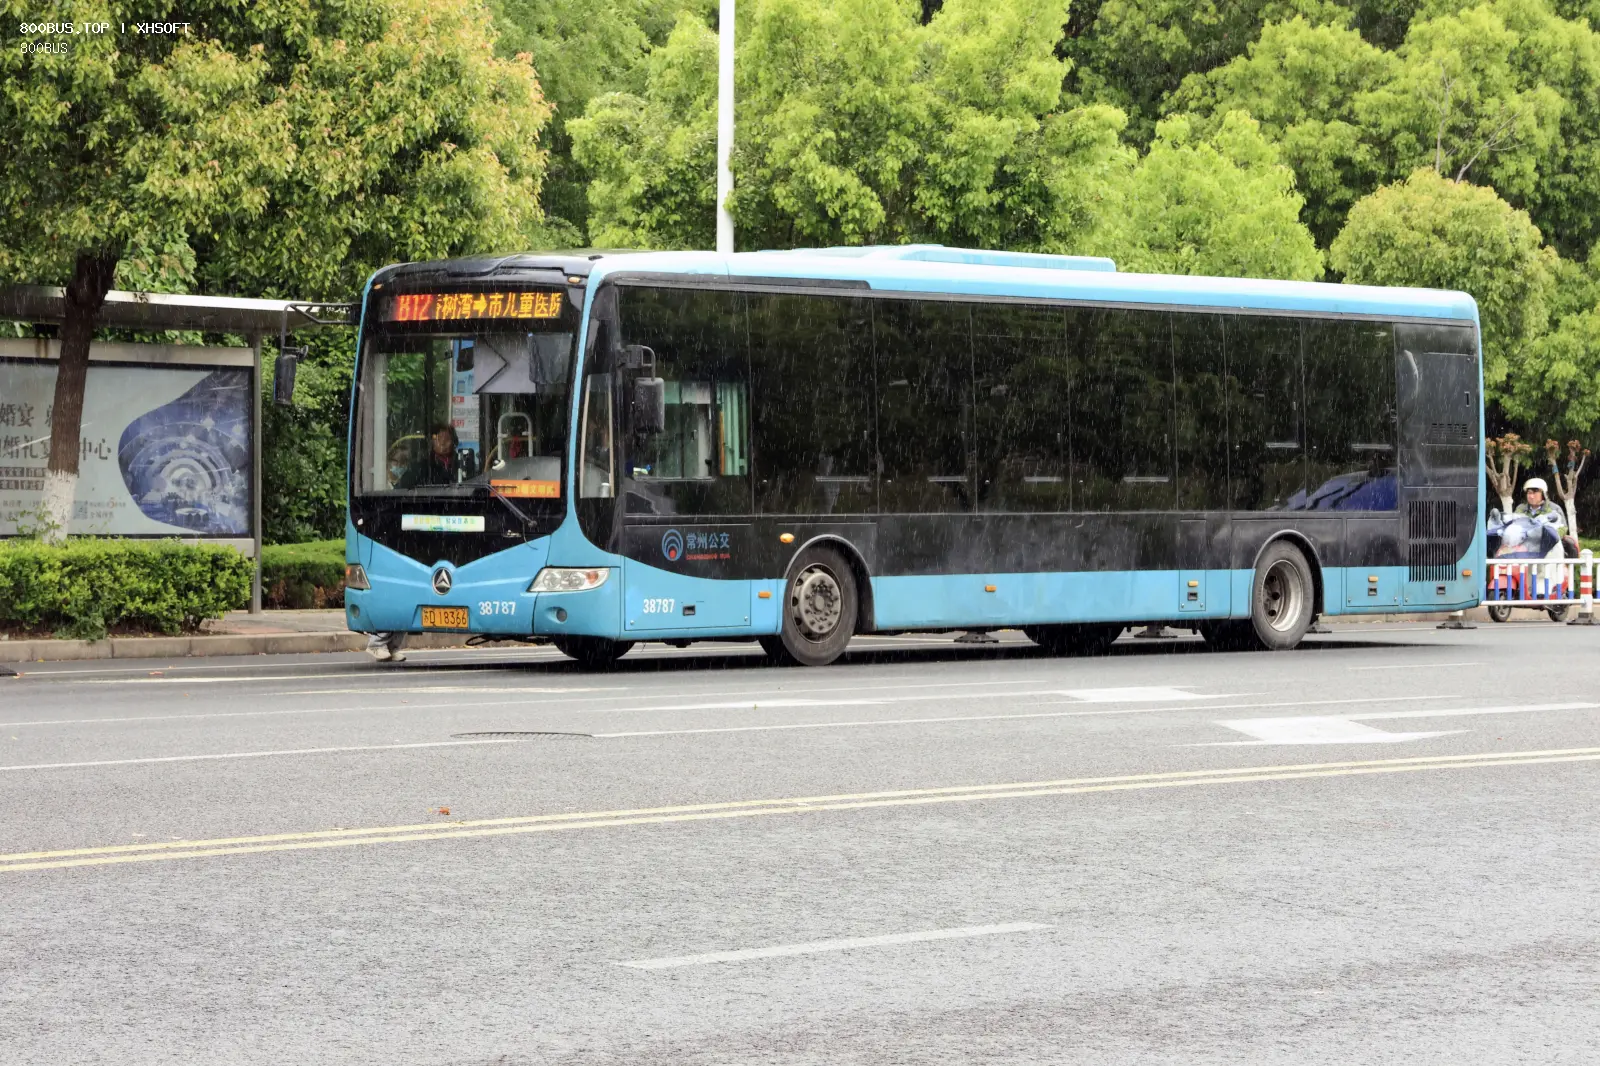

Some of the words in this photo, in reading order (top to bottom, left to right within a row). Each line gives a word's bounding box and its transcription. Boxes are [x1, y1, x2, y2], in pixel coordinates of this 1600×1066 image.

[397, 294, 433, 321] B12
[686, 532, 730, 550] 常州公交
[478, 601, 517, 616] 38787
[643, 598, 676, 614] 38787
